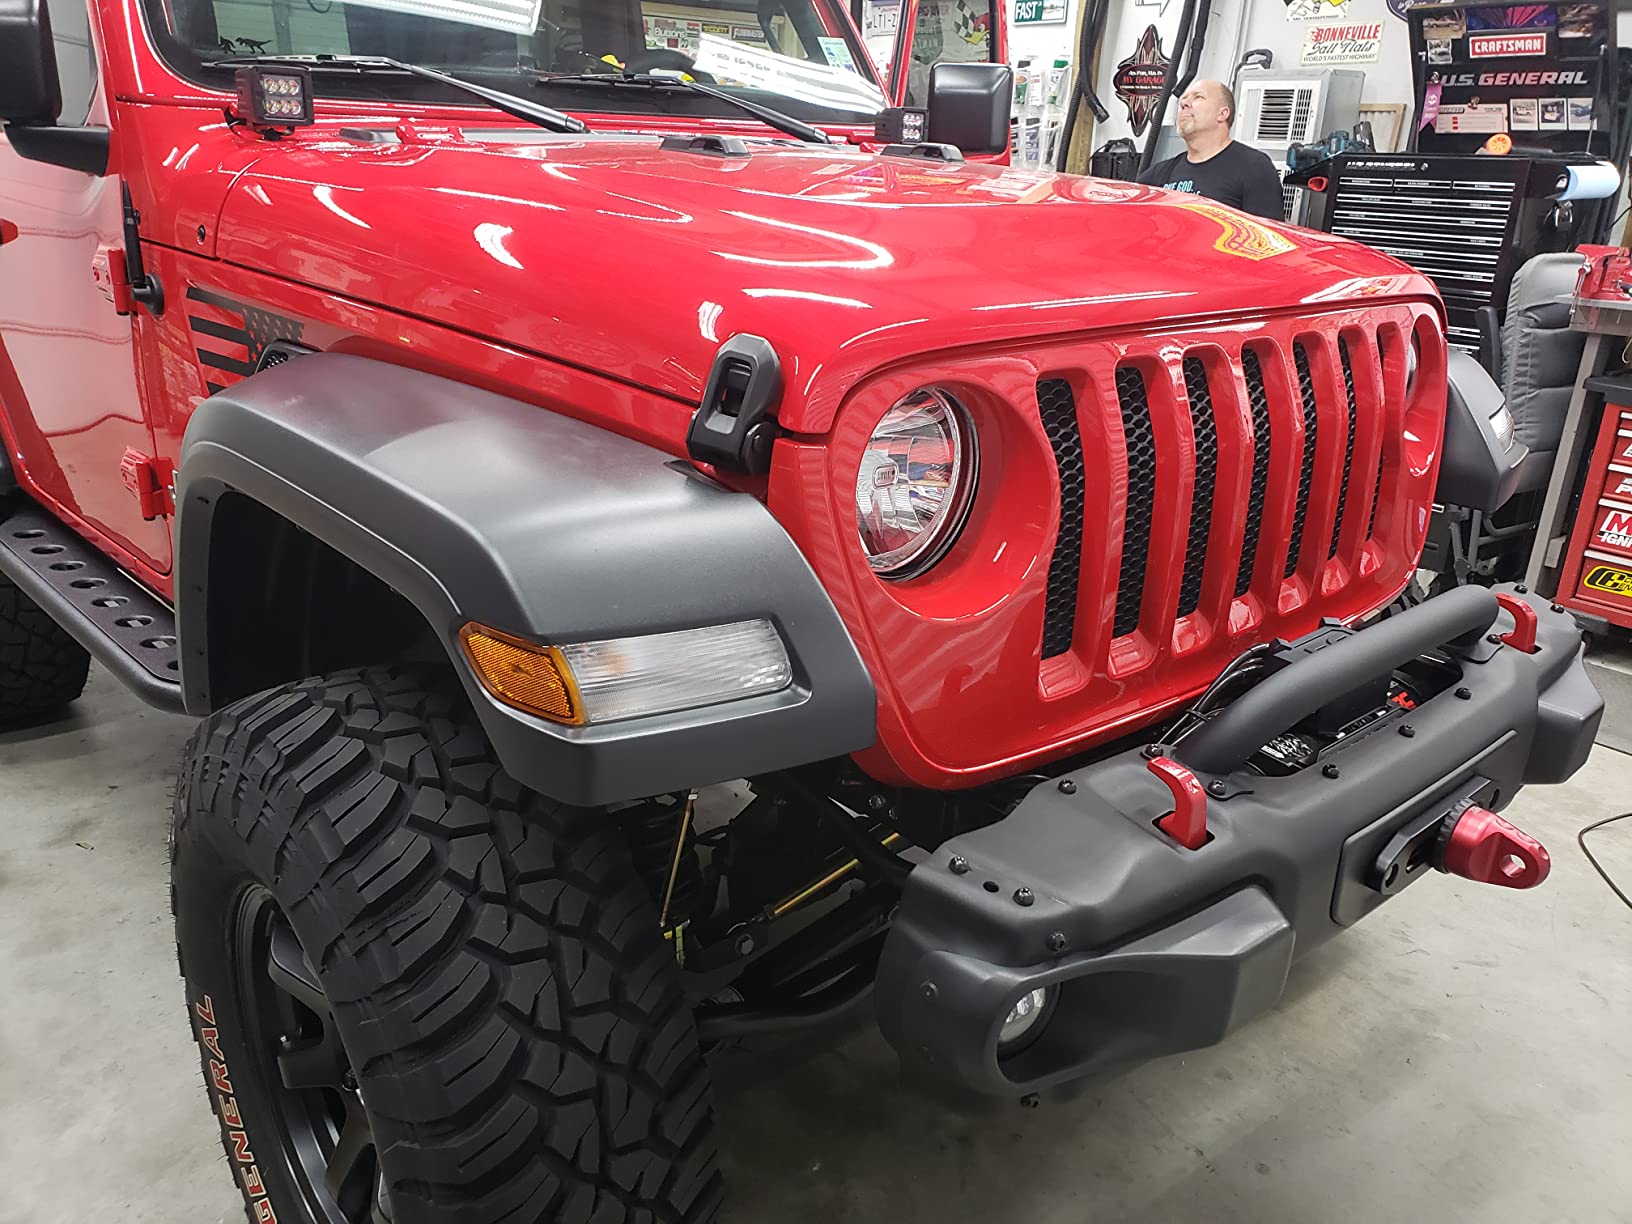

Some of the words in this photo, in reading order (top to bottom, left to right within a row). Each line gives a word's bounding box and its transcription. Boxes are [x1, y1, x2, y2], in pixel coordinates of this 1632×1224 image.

[1016, 2, 1038, 20] FAST
[1312, 24, 1381, 42] BONNEVILLE
[1475, 39, 1541, 53] CRAFTSMAN
[1441, 74, 1475, 87] U.S.
[1478, 71, 1588, 86] GENERAL
[196, 994, 278, 1224] GENERAL
